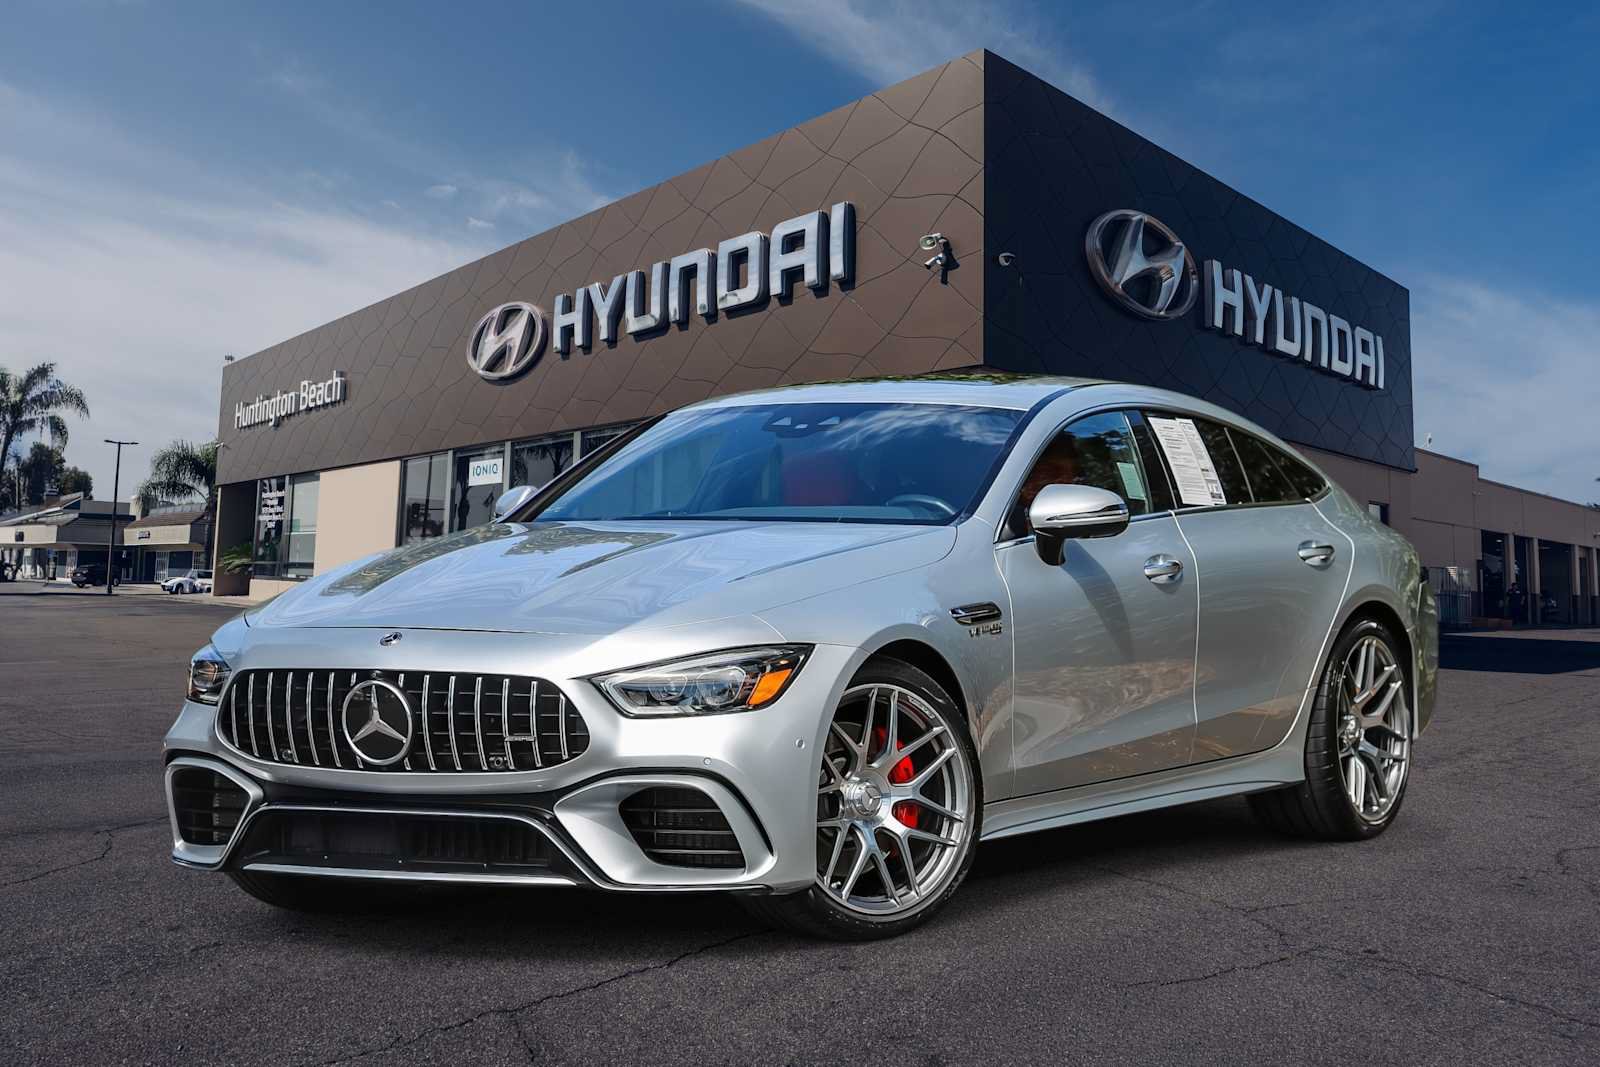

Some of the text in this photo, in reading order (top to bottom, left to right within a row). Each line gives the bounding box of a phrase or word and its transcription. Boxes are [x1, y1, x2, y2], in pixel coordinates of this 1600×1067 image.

[553, 201, 855, 353] HYUNDAI
[1205, 259, 1385, 389] HYUNDAI
[234, 370, 345, 429] Huntington Beach
[472, 463, 499, 477] IONIQ
